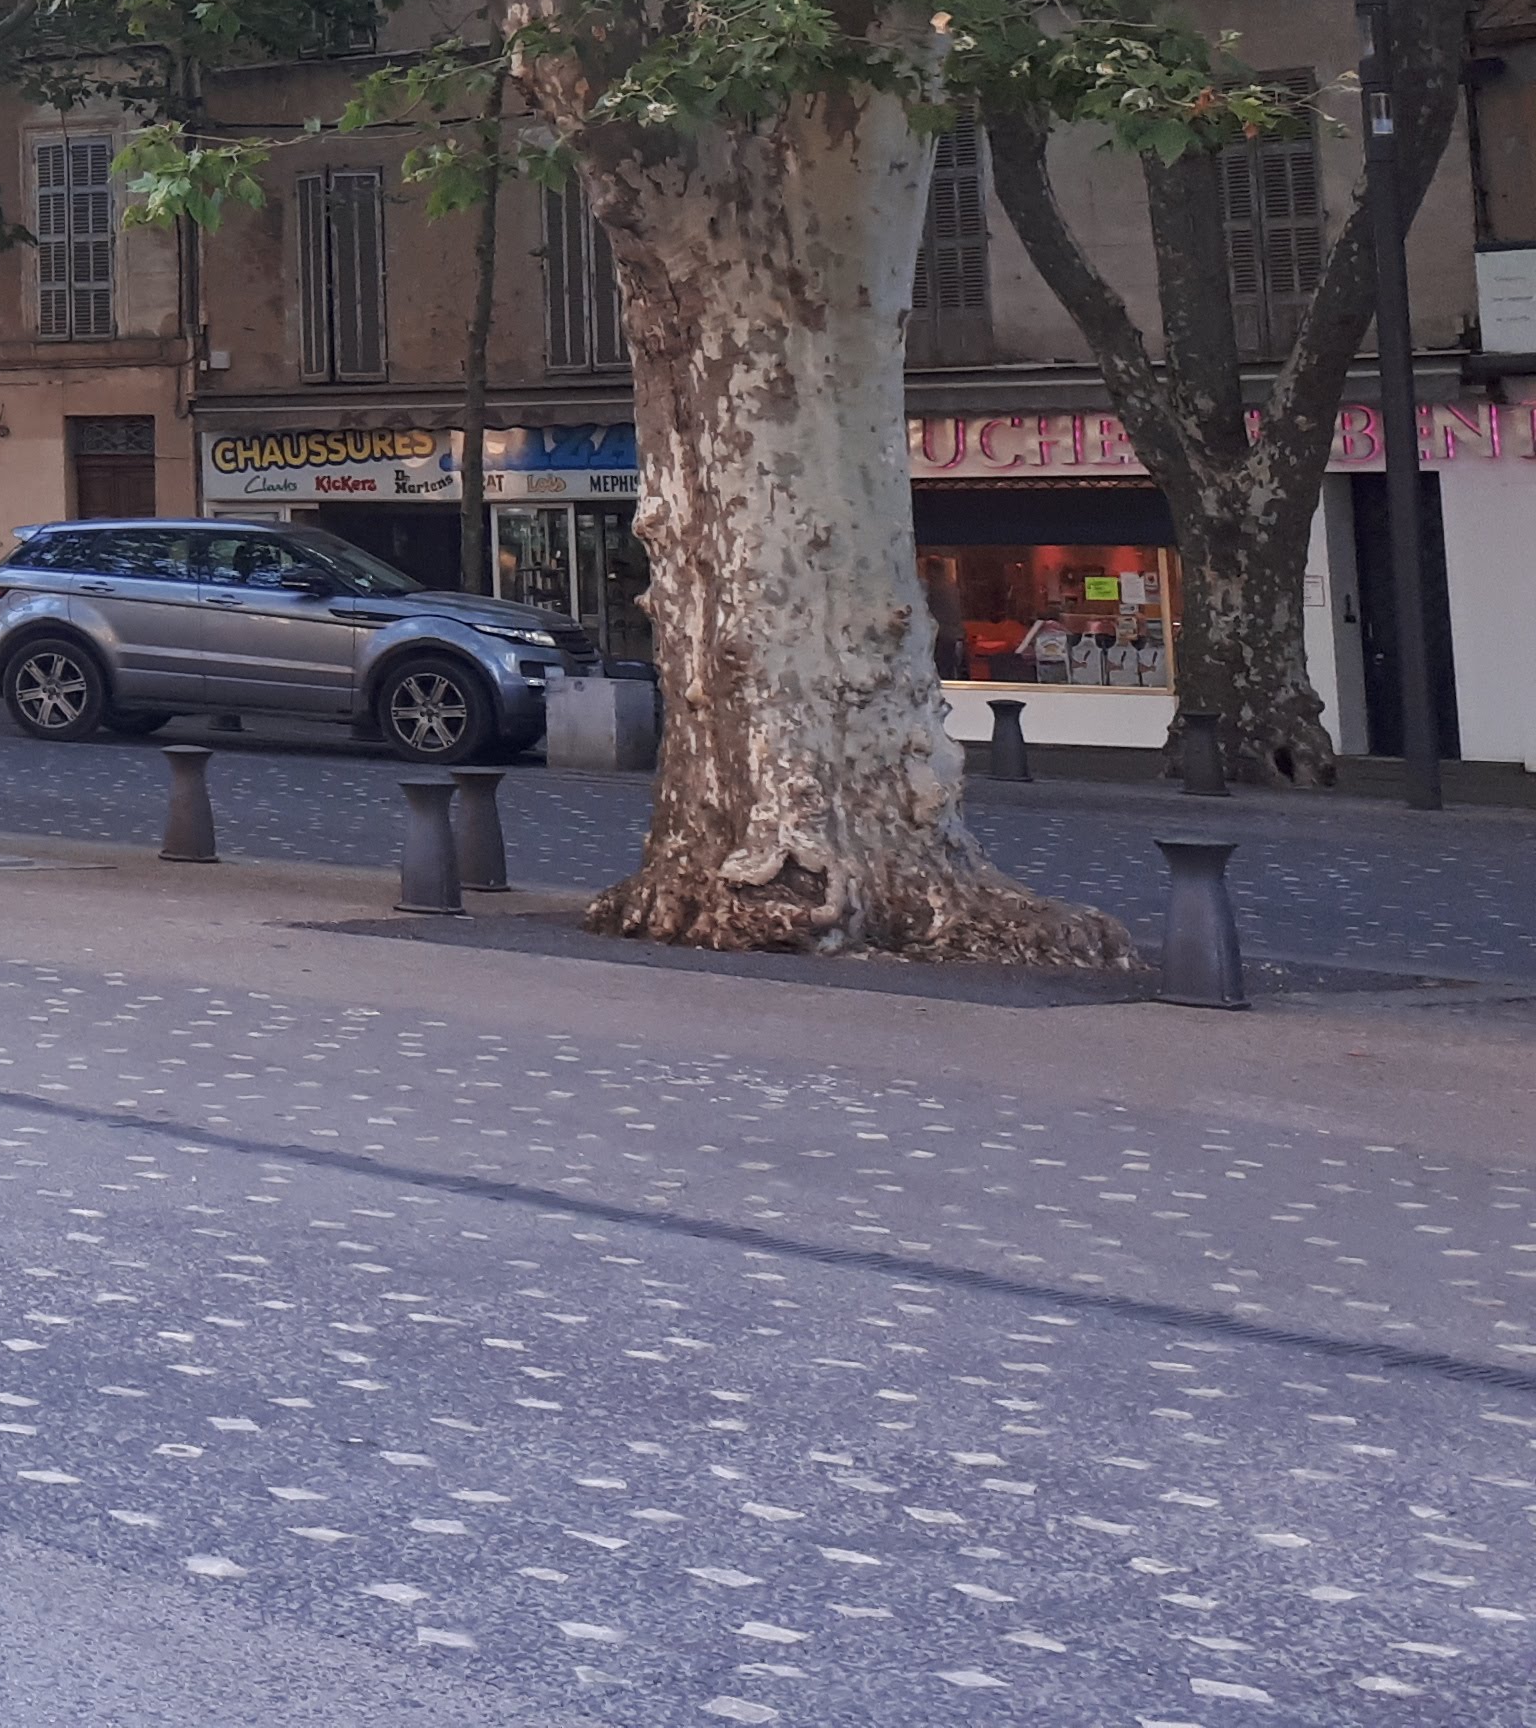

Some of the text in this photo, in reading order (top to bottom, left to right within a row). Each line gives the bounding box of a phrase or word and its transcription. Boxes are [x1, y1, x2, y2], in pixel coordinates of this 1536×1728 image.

[212, 428, 436, 474] CHAUSSURES
[243, 475, 298, 495] Clarks
[394, 474, 455, 495] Martens
[589, 475, 639, 494] MEPHIS
